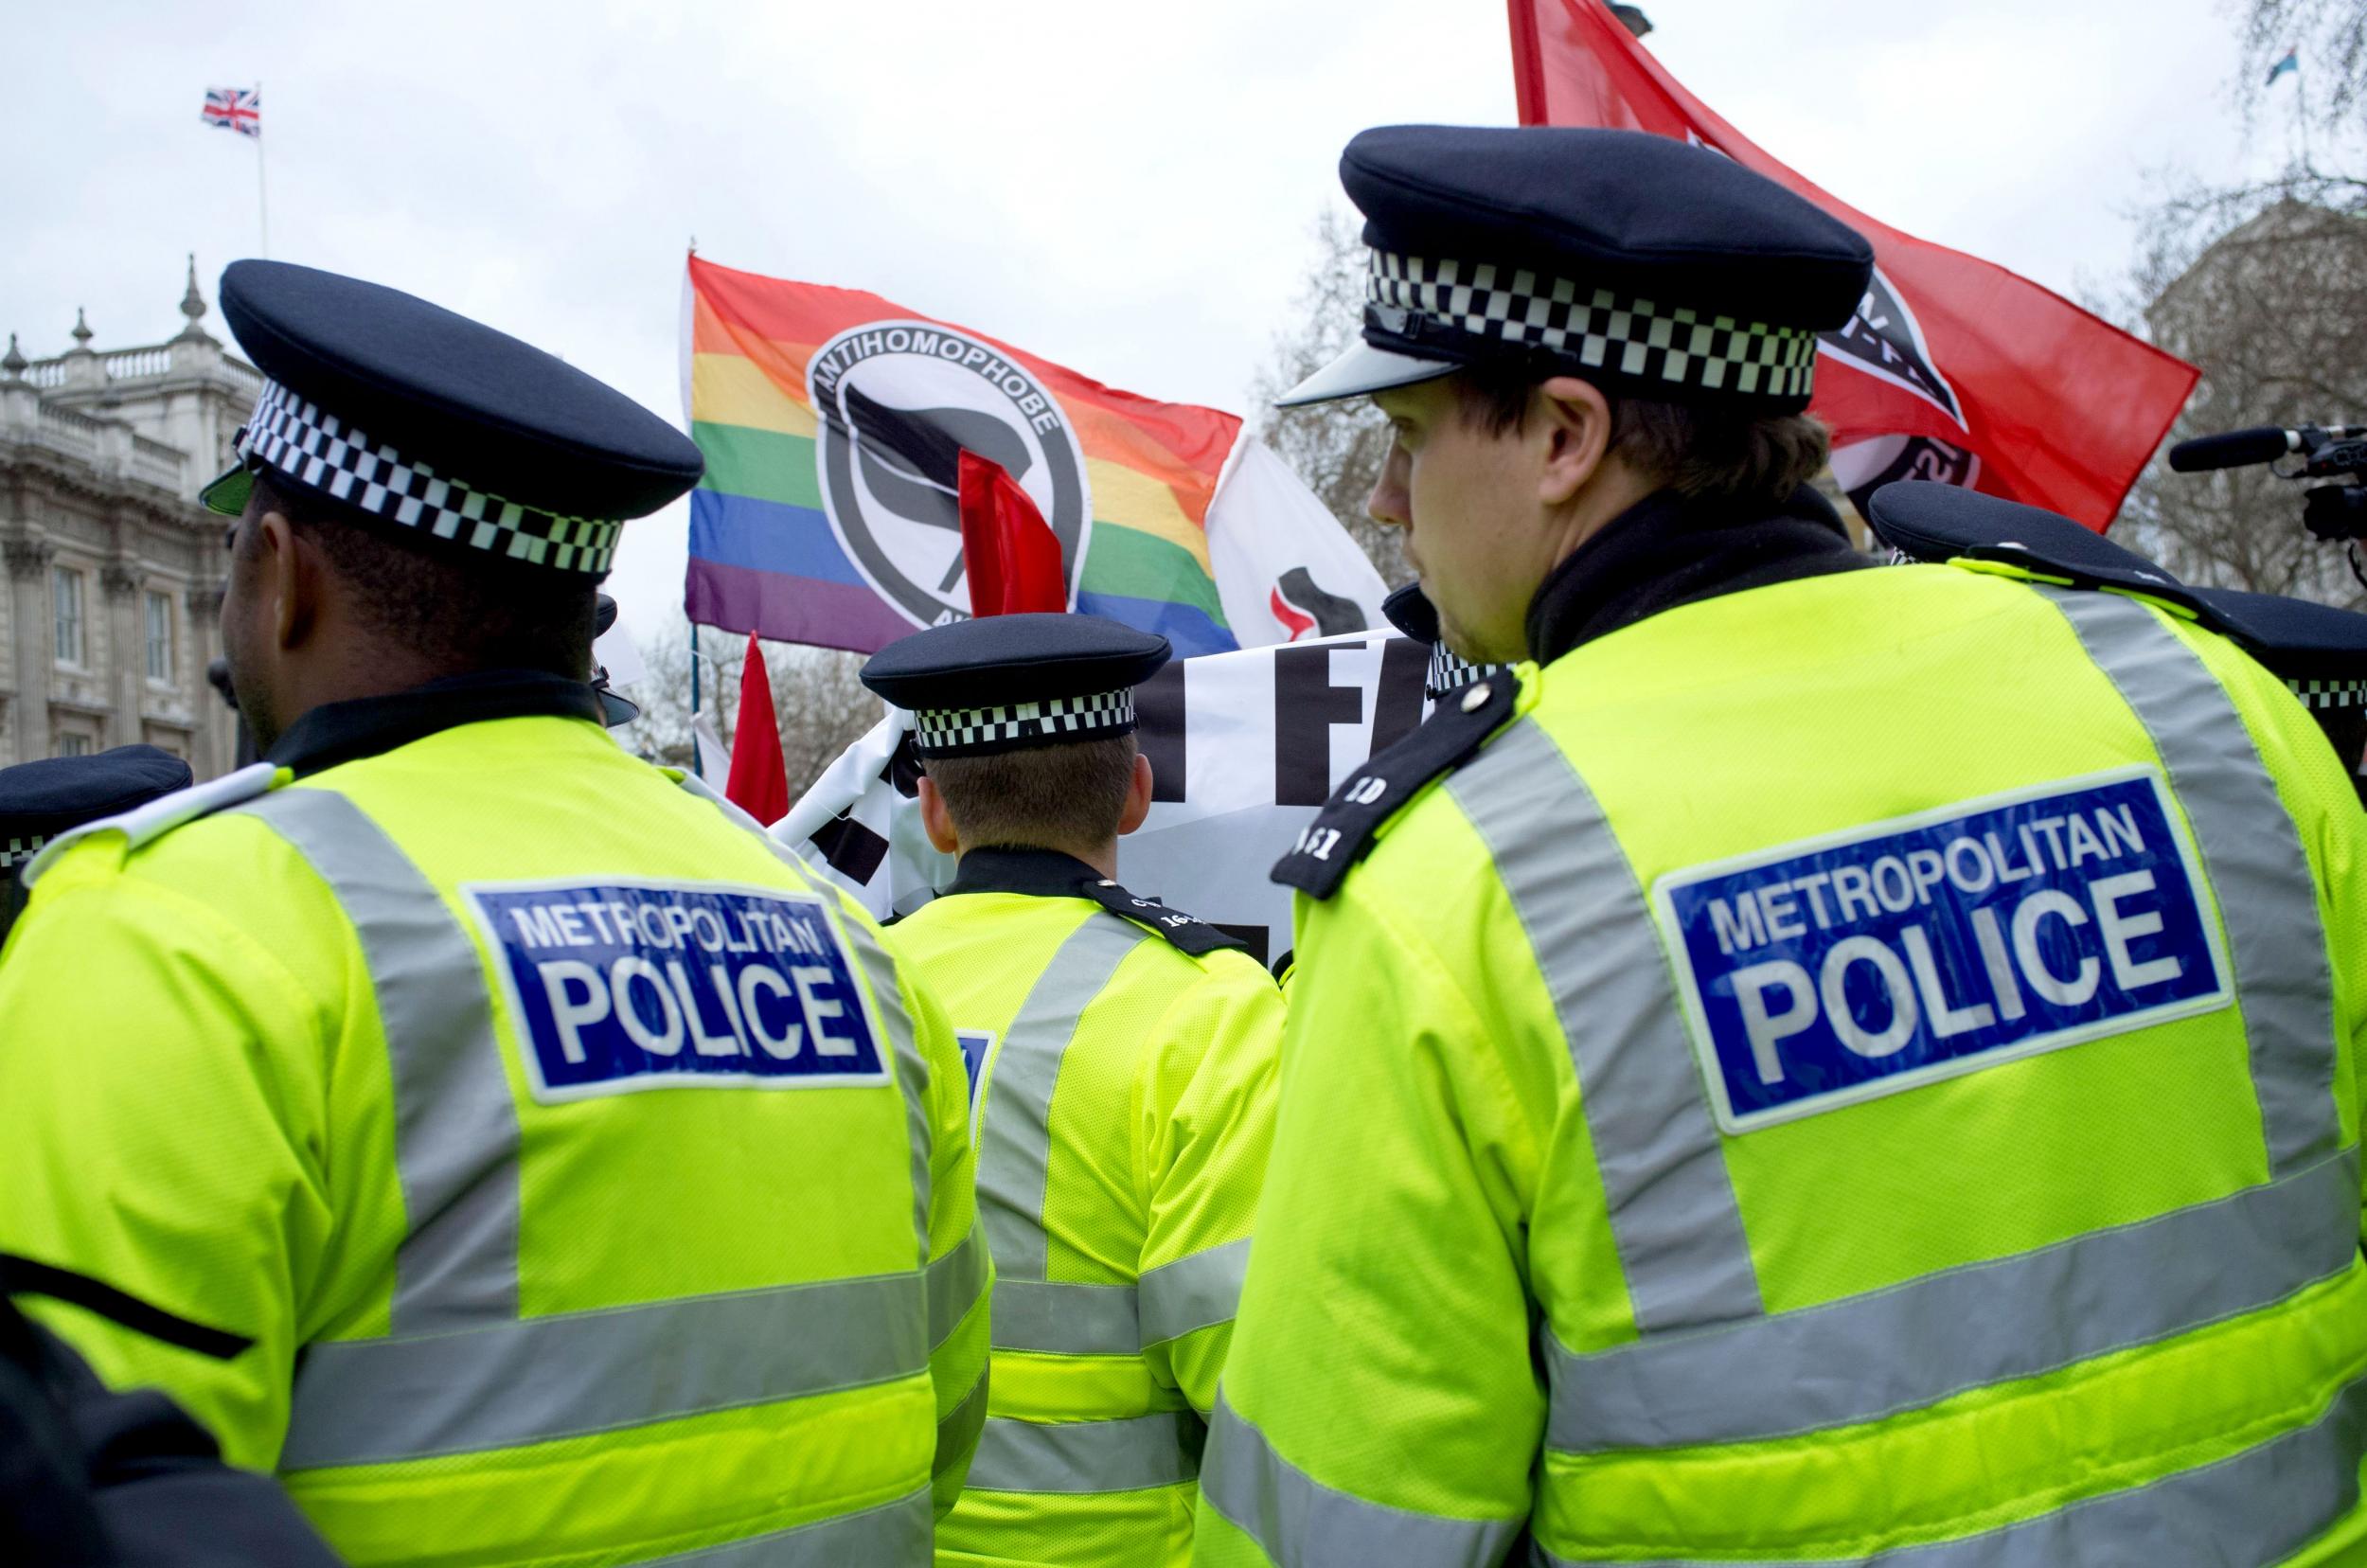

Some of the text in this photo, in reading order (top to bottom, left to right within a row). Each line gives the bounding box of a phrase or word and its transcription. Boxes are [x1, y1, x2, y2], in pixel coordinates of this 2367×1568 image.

[813, 329, 1060, 436] ANTIHOMOPHOBE
[508, 901, 824, 955] METROPOLITAN
[1708, 803, 2146, 955] METROPOLITAN
[538, 955, 859, 1064] POLICE
[1731, 869, 2183, 1086] POLICE
